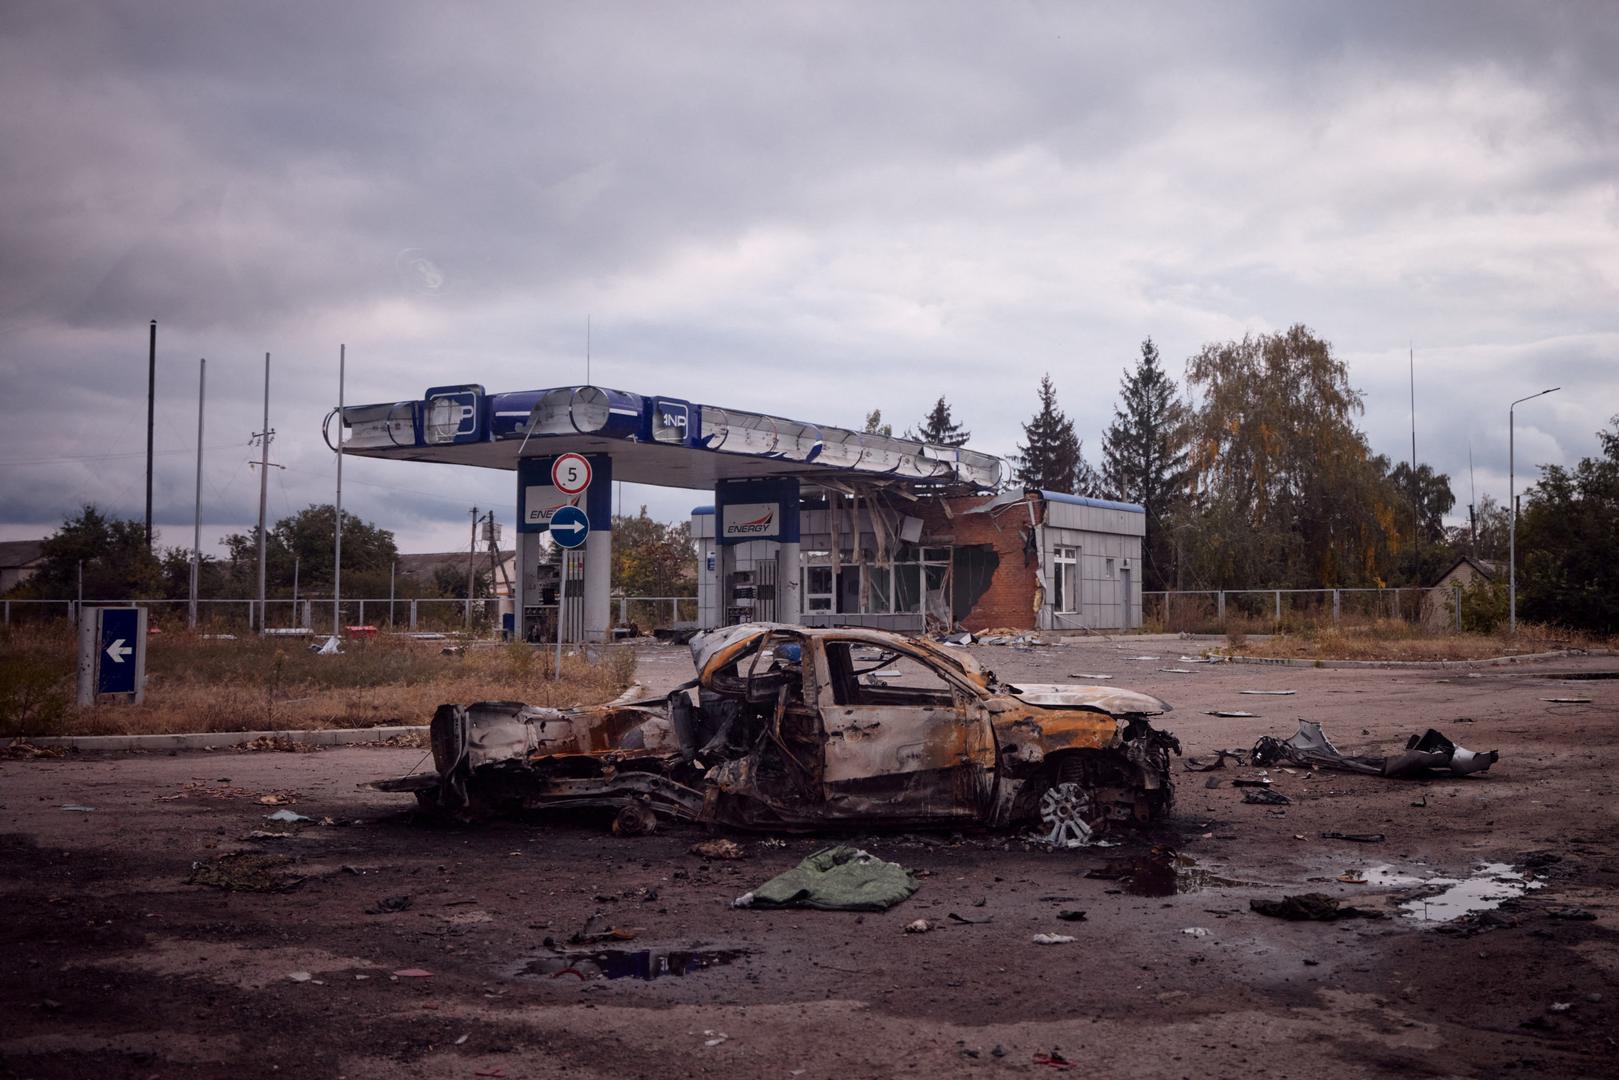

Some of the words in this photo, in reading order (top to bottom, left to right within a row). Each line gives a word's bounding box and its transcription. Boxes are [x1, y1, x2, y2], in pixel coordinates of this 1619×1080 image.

[567, 467, 577, 482] 5
[530, 509, 554, 519] ENE
[727, 524, 770, 533] ENERGY
